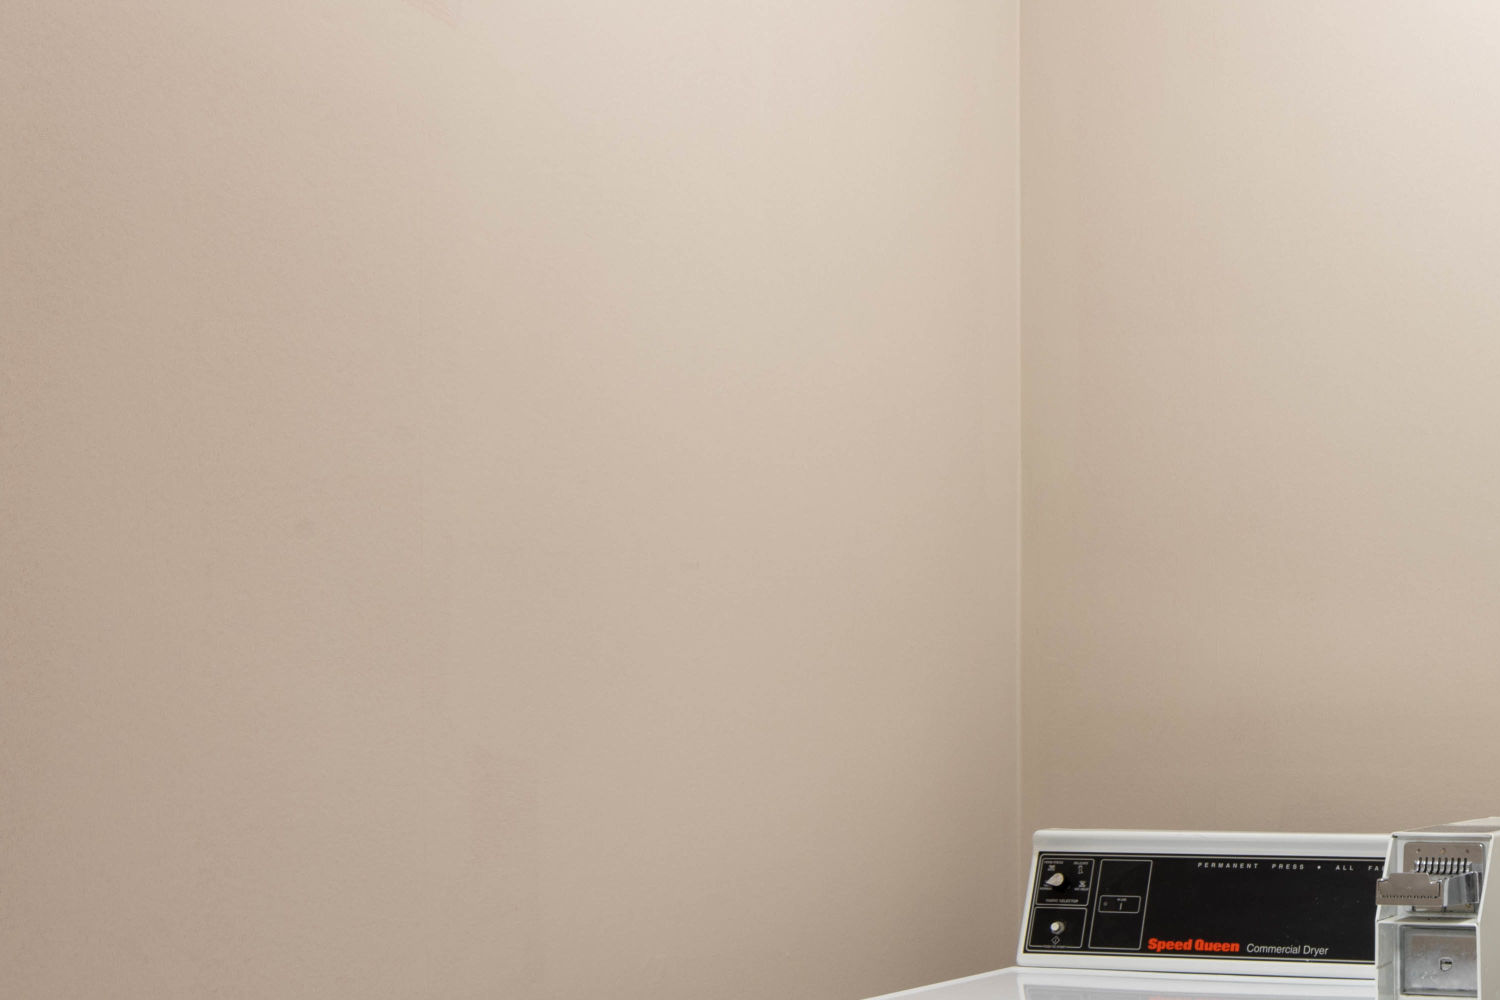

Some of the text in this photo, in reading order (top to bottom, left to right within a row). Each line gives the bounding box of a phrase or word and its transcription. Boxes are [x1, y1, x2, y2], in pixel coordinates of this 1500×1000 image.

[1147, 937, 1329, 957] Speed Queen Commercial Dryer
